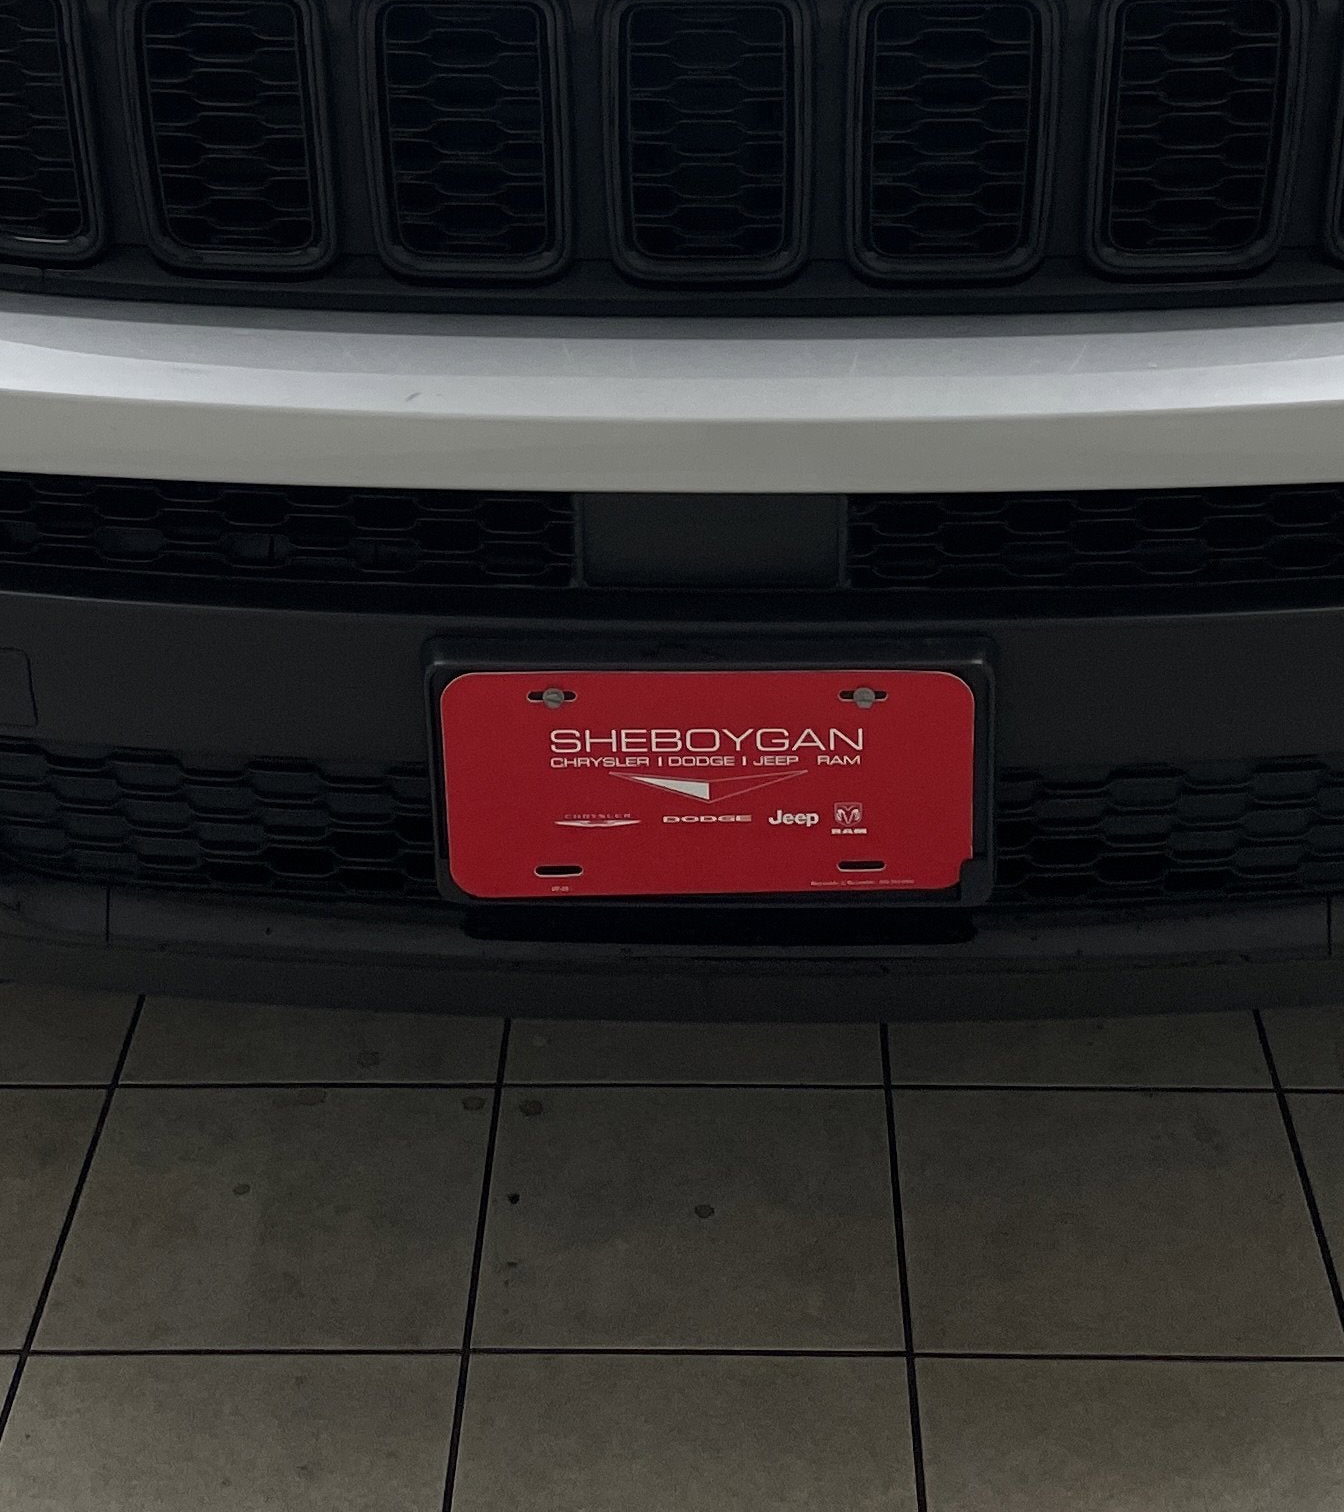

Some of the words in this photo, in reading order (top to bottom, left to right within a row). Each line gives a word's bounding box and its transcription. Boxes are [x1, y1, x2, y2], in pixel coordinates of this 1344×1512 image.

[549, 727, 864, 753] SHEBOYGAN
[550, 756, 650, 769] CHRYSLER
[668, 755, 736, 767] DODGE
[752, 755, 800, 767] JEEP
[817, 754, 862, 766] RAM
[662, 814, 752, 823] DODGE
[768, 809, 819, 827] Jeep
